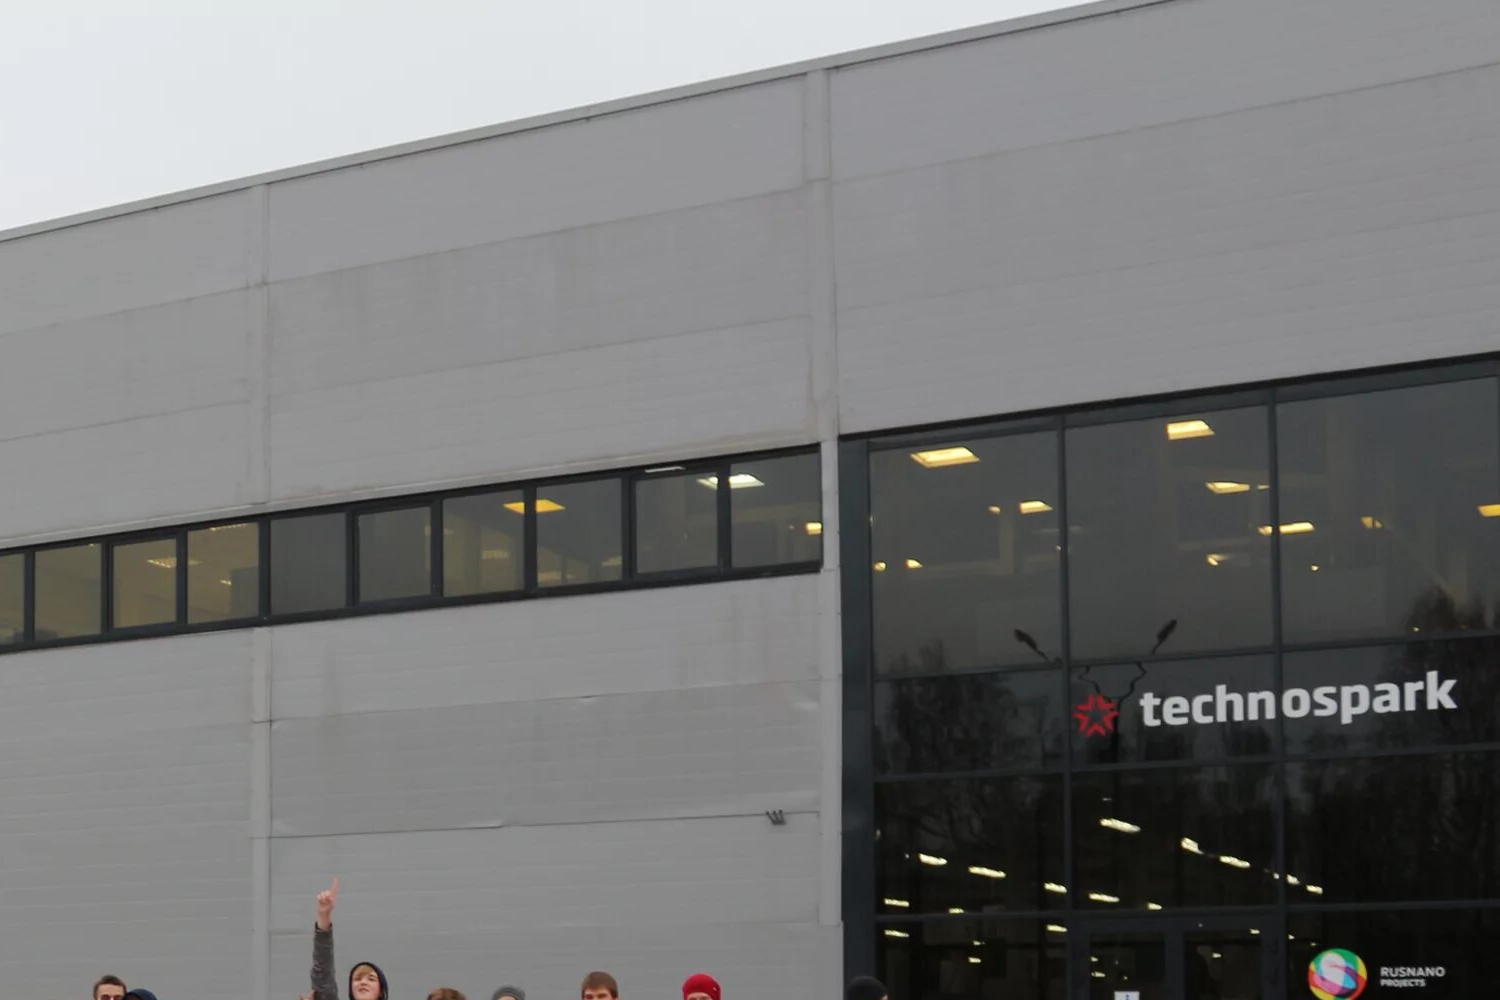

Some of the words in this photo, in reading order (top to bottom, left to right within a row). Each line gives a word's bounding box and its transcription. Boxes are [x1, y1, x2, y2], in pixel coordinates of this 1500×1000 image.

[1140, 670, 1458, 727] technospark
[1380, 966, 1446, 977] RUSNANO
[1380, 979, 1426, 988] PROJECTS
